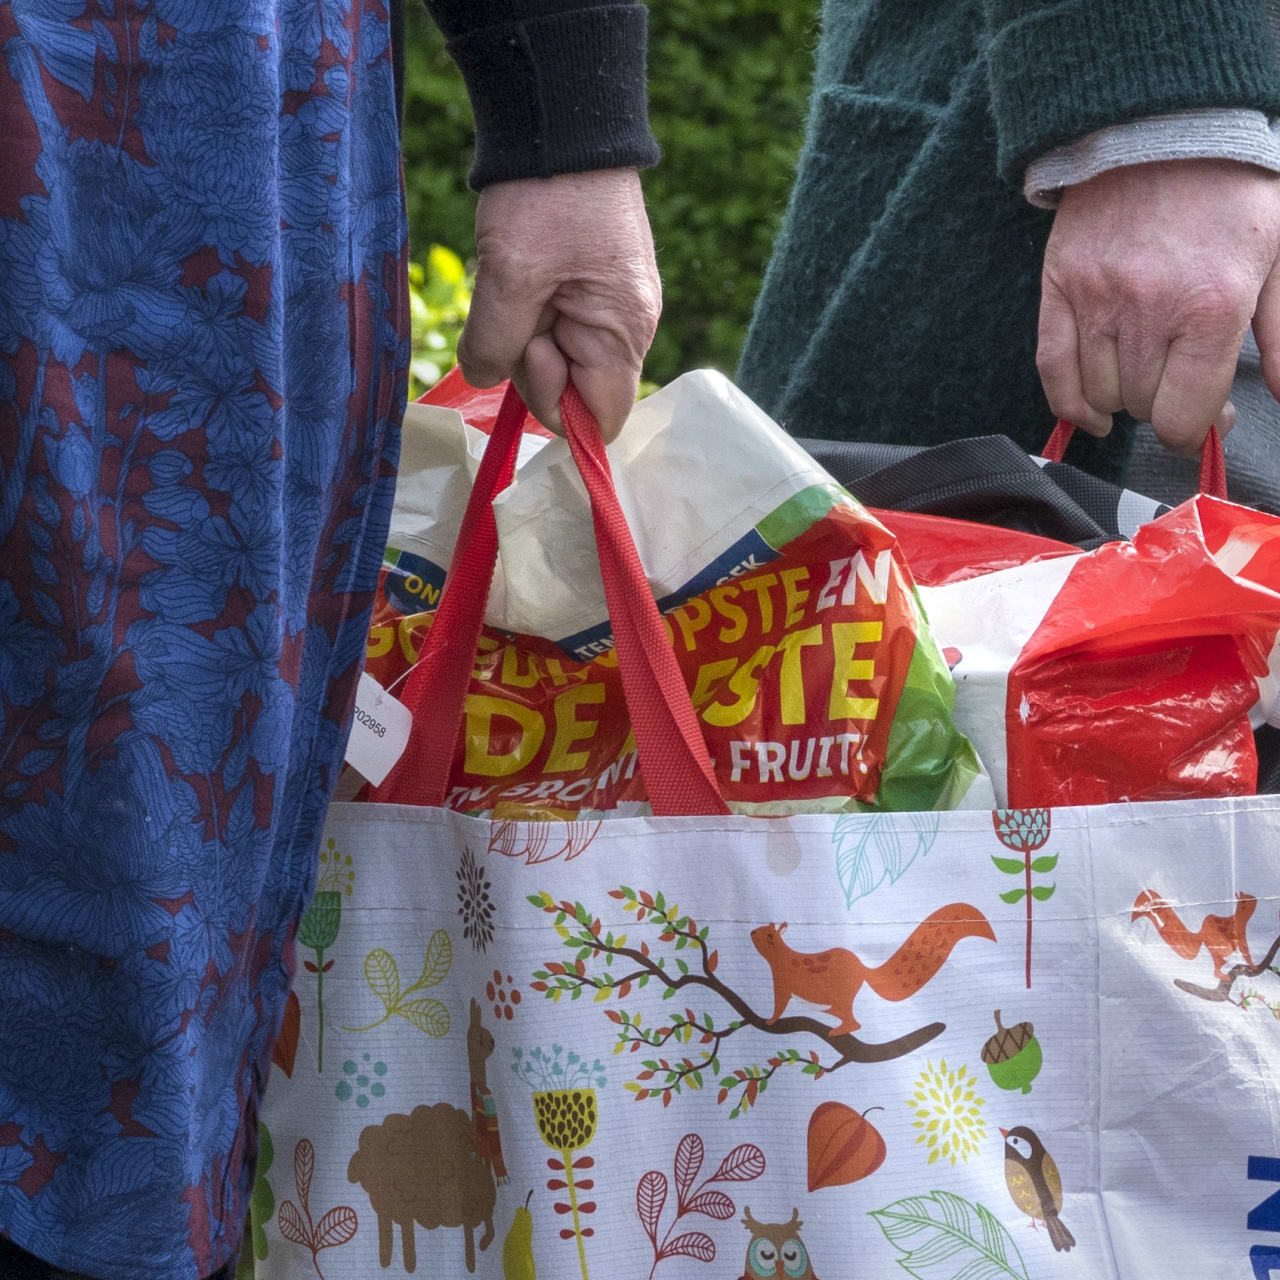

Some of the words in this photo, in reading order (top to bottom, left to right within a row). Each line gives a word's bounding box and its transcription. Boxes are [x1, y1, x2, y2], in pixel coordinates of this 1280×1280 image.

[816, 550, 892, 613] EN
[463, 682, 606, 777] DE
[729, 733, 869, 784] FRUIT!
